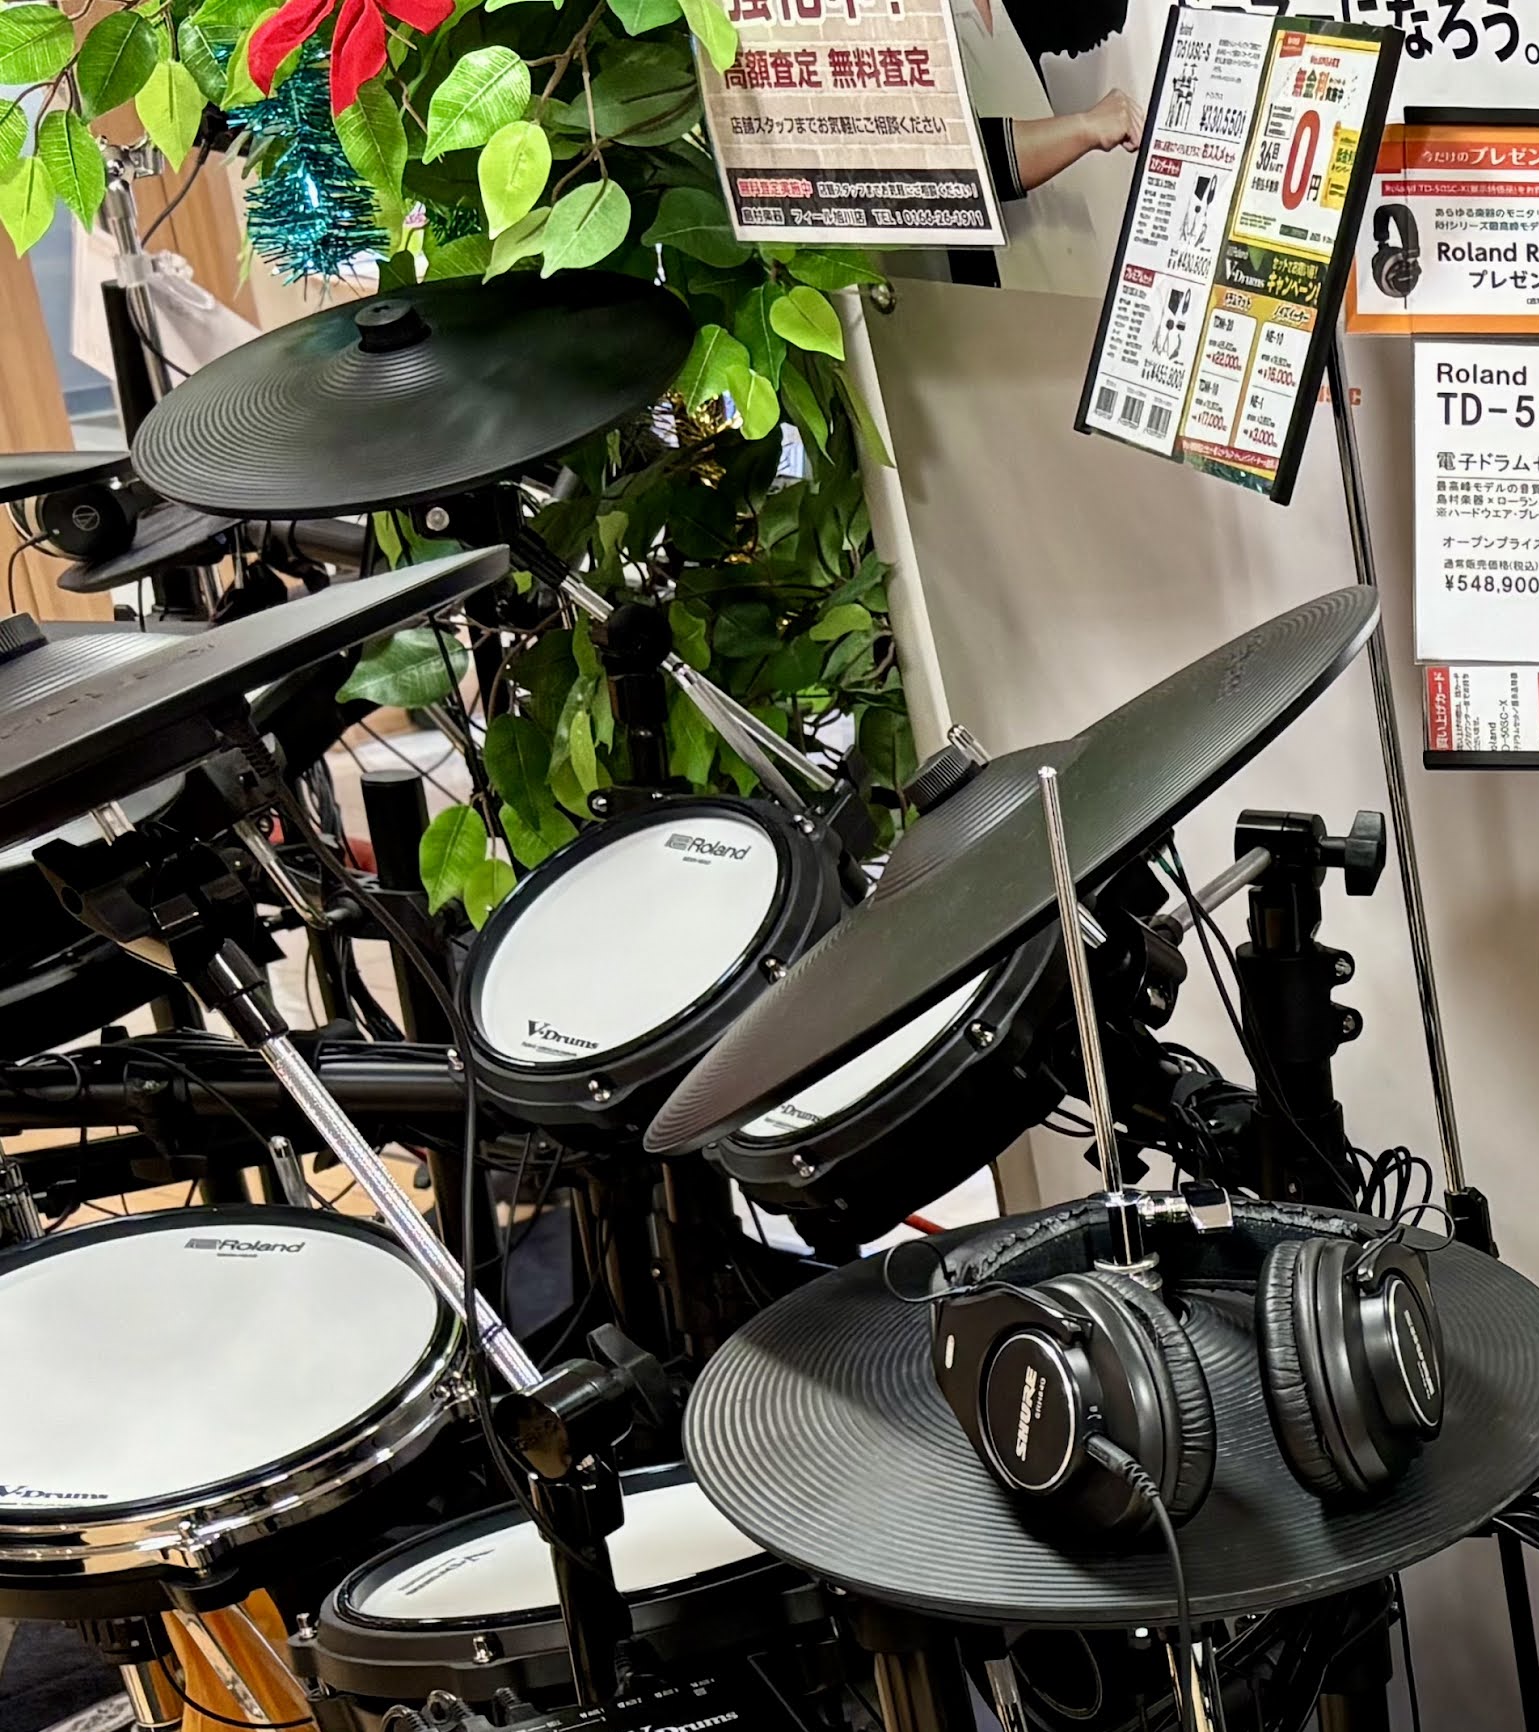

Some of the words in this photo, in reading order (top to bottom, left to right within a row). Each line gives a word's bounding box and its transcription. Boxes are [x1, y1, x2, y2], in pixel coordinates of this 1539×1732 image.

[724, 47, 822, 90] 高額査定
[828, 47, 936, 89] 無料査定
[731, 115, 947, 136] 店舗スタッフまでお気軽にご相談ください
[1437, 242, 1517, 263] Roland
[1436, 362, 1528, 386] Roland
[688, 836, 752, 862] Roland
[218, 1237, 306, 1254] Roland
[1015, 1363, 1039, 1462] SHURE
